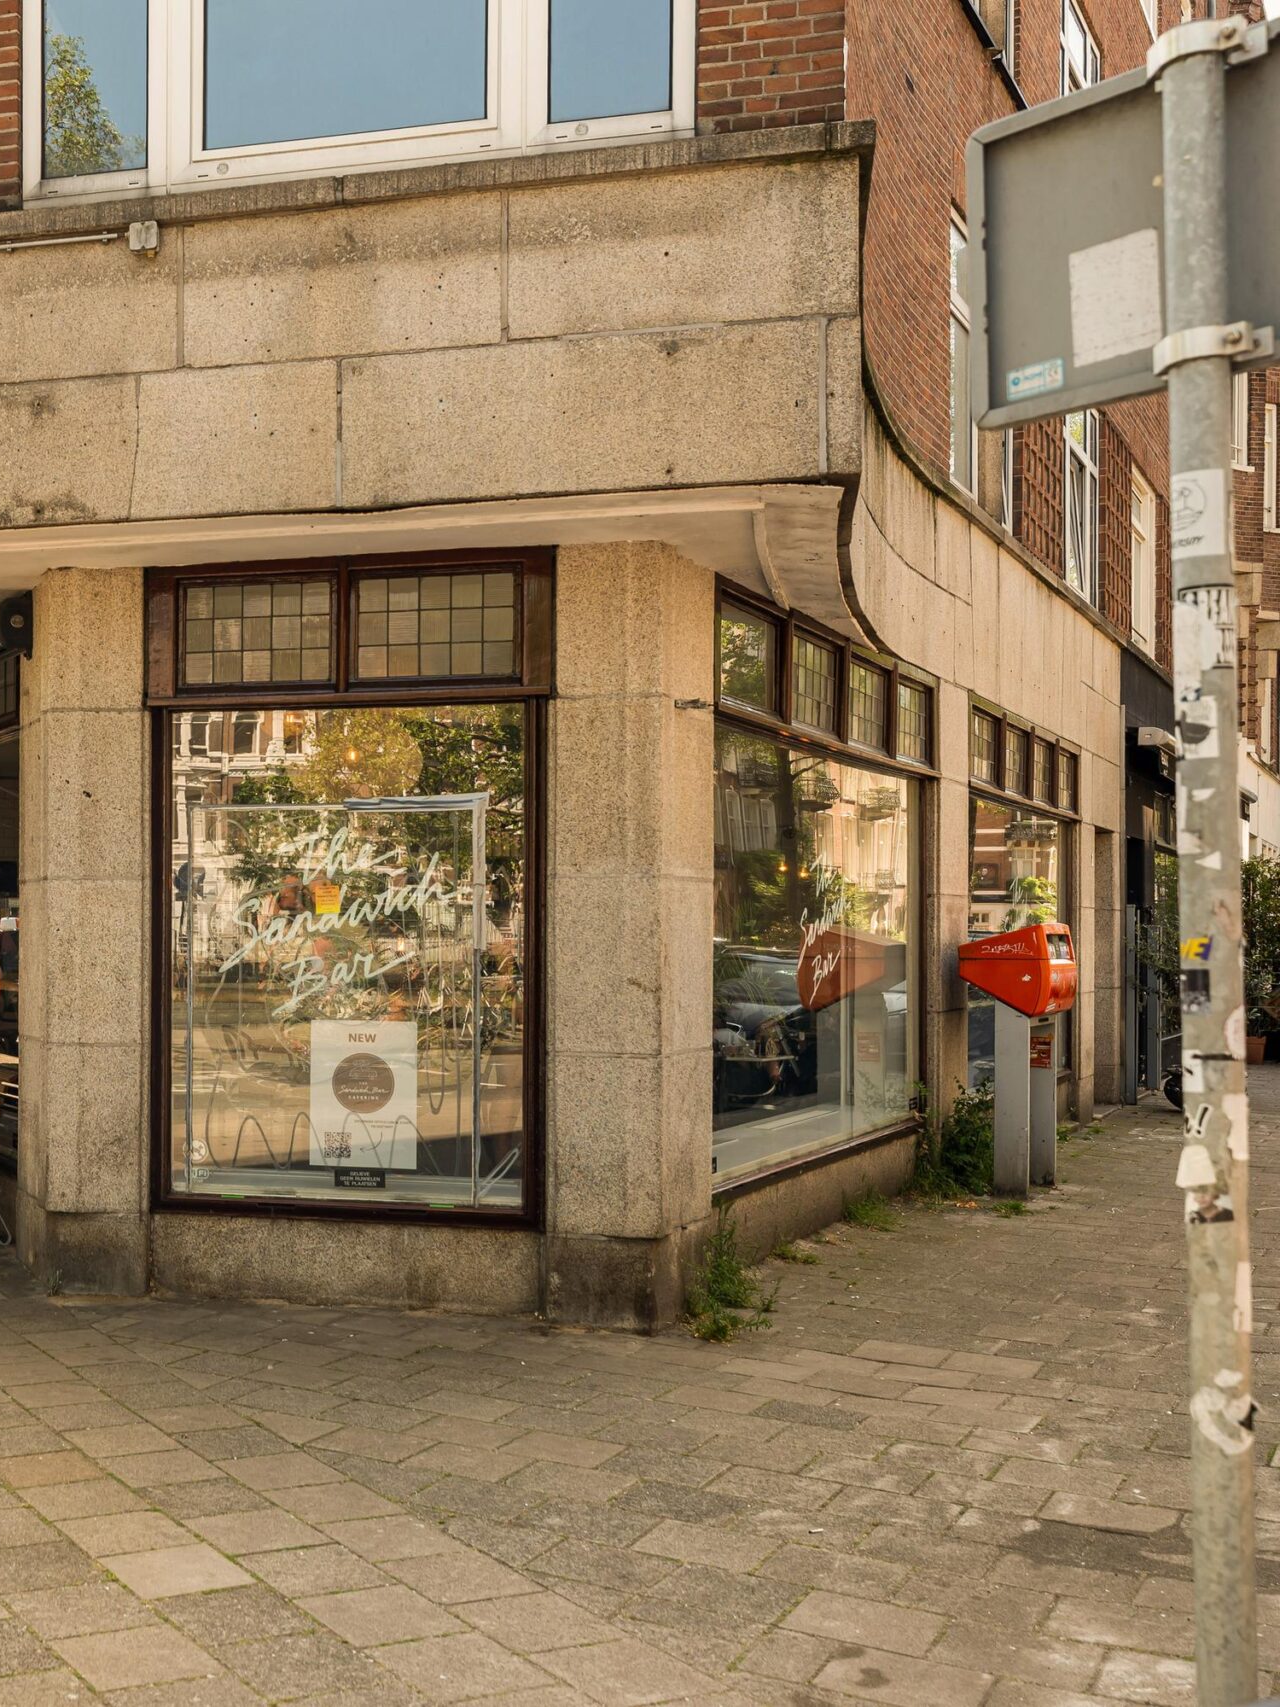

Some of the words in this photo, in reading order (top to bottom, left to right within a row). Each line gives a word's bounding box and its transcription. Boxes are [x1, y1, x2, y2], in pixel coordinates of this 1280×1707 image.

[276, 826, 402, 885] The
[219, 851, 462, 973] Sandwich
[271, 952, 416, 1017] Bar
[809, 950, 841, 1005] Bar
[348, 1033, 377, 1043] NEW
